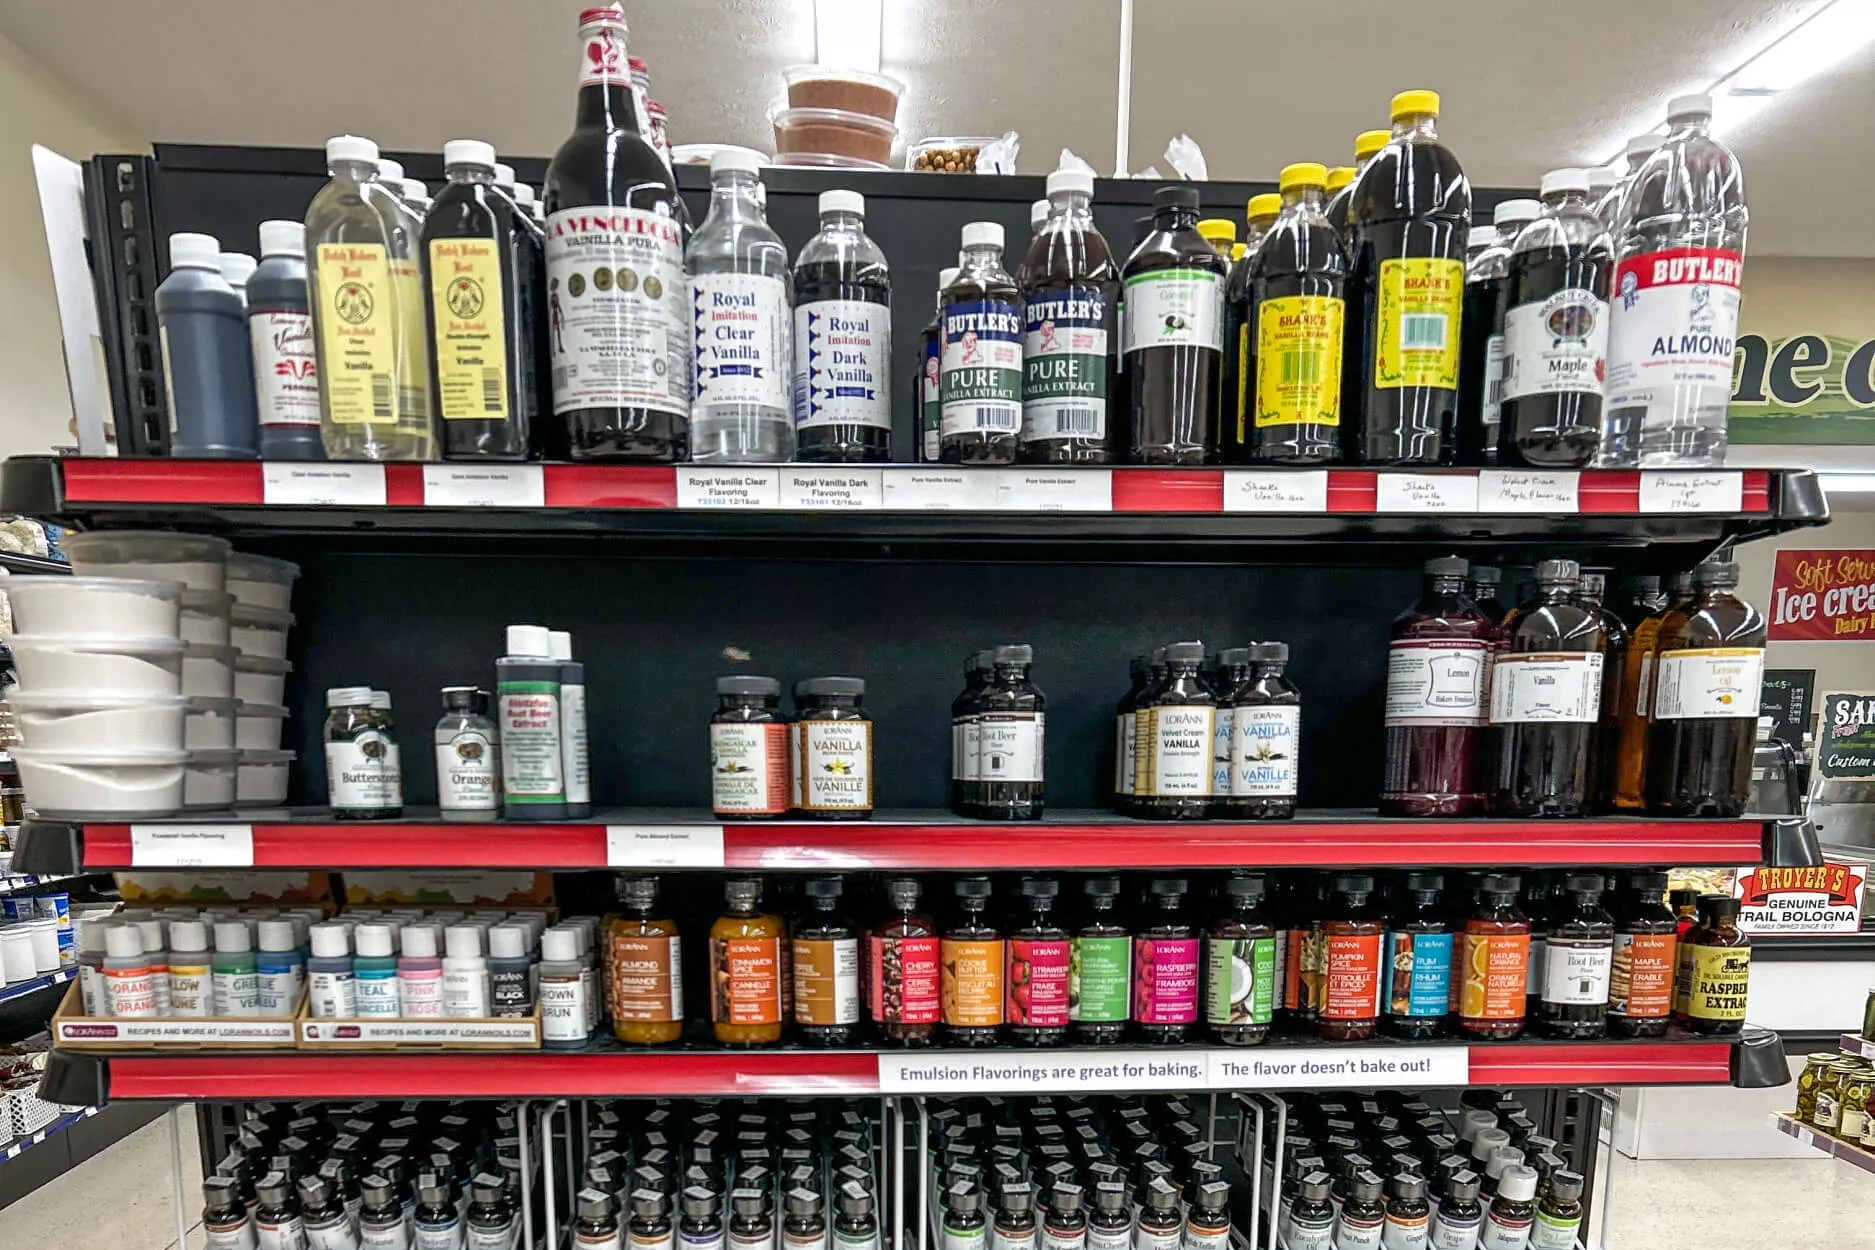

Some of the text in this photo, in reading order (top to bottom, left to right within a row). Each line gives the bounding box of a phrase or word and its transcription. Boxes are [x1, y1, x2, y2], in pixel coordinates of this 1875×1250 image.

[1653, 256, 1742, 284] BUTLER'S
[712, 291, 756, 310] Royal
[711, 310, 758, 322] Imitation
[1027, 299, 1102, 322] BUTLER'S
[829, 317, 870, 334] Royal
[947, 313, 1019, 334] BUTLER'S
[1278, 314, 1327, 328] SHANK'S
[715, 326, 756, 341] Clear
[828, 334, 872, 347] Imitation
[1652, 334, 1733, 357] ALMOND
[711, 345, 760, 361] Vanilla
[832, 350, 868, 365] Dark
[1029, 359, 1079, 381] PURE
[1548, 359, 1588, 374] Maple
[827, 367, 873, 384] Vanilla
[950, 369, 999, 389] PURE
[1053, 381, 1095, 393] EXTRACT
[974, 388, 1014, 399] EXTRACT
[689, 477, 768, 487] Royal Vanilla Clear
[793, 478, 869, 488] Royal Vanilla Dark
[708, 488, 749, 497] Flavoring
[811, 489, 851, 498] Flavoring
[1794, 559, 1834, 592] Soft
[1774, 586, 1817, 625] Ice
[1834, 616, 1868, 634] Dairy
[1243, 727, 1291, 737] VANILLA
[813, 741, 862, 751] VANILLA
[1163, 739, 1201, 749] VANILLA
[1828, 753, 1871, 768] Custom
[1241, 770, 1289, 781] VANILLE
[815, 782, 863, 792] VANILLE
[1759, 866, 1845, 892] TROYER'S
[1768, 899, 1826, 909] GENUINE
[1737, 911, 1856, 923] TRAIL BOLOGNA
[1416, 957, 1437, 966] RUM
[1634, 958, 1662, 966] MAPLE
[359, 985, 385, 996] TEAL
[406, 984, 435, 995] PINK
[495, 991, 525, 999] BLACK
[407, 1004, 439, 1015] ROSE
[163, 1027, 181, 1035] AND
[182, 1027, 203, 1035] MORE
[206, 1027, 217, 1035] AT
[900, 1058, 1431, 1082] Emulsion Flavorings are great for baking. The flavor doesn't bake out!
